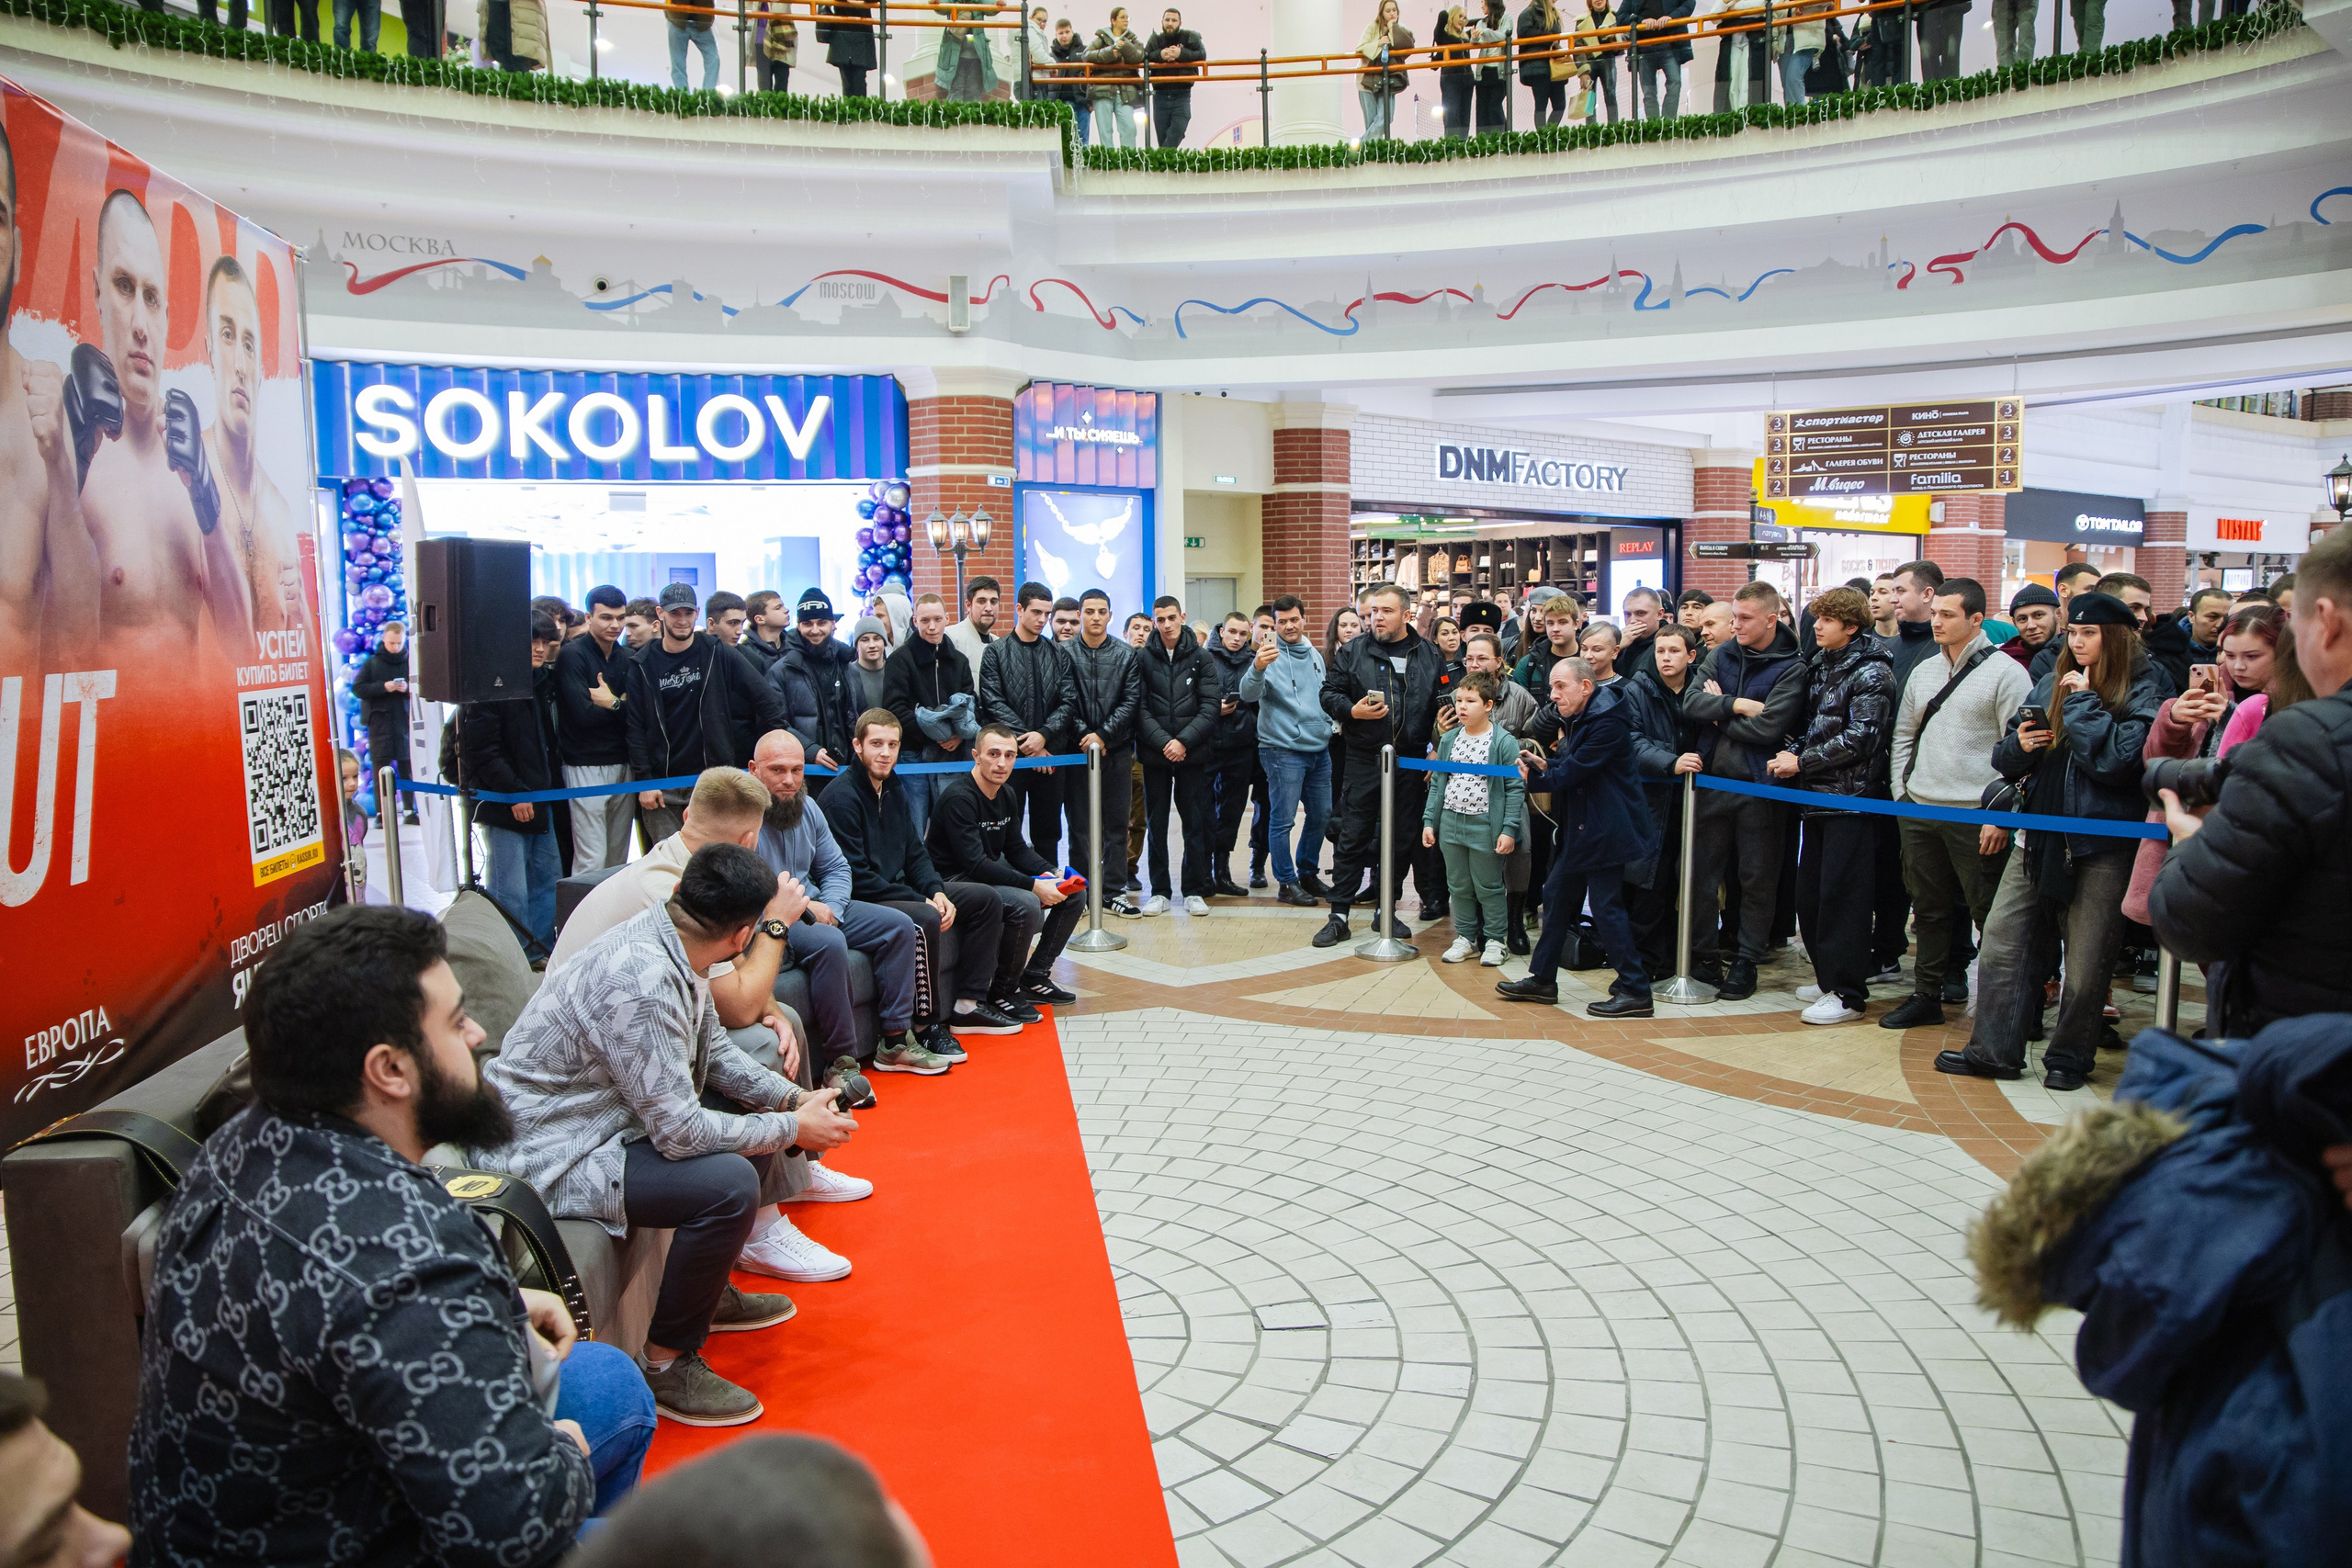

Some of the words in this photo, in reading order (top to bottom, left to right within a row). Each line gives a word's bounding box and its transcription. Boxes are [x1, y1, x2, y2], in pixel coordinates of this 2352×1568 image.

[341, 231, 458, 257] МОСКВА
[2004, 403, 2012, 414] 3
[355, 384, 831, 460] SOKOLOV
[1774, 418, 1781, 428] 3
[1917, 429, 1951, 439] ДЕТСКАЯ
[1953, 428, 1985, 436] ГАЛЕРЕЯ
[2004, 425, 2012, 436] 3
[1066, 427, 1086, 441] ТЫ
[1087, 428, 1140, 446] СИЯЕШЬ
[1807, 435, 1852, 444] РЕСТОРАНЫ
[1774, 438, 1781, 448] 3
[1909, 452, 1956, 460] РЕСТОРАНЫ
[2003, 448, 2011, 459] 2
[1774, 459, 1781, 468] 2
[1826, 459, 1856, 468] ГАЛЕРЕЯ
[1774, 480, 1781, 491] 2
[1619, 541, 1655, 555] REPLAY
[256, 624, 308, 660] УСПЕЙ
[236, 664, 277, 687] КУПИТЬ
[278, 660, 309, 682] БИЛЕТ
[231, 920, 282, 968] ДВОРЕЦ
[25, 1005, 111, 1070] ЕВРОПА
